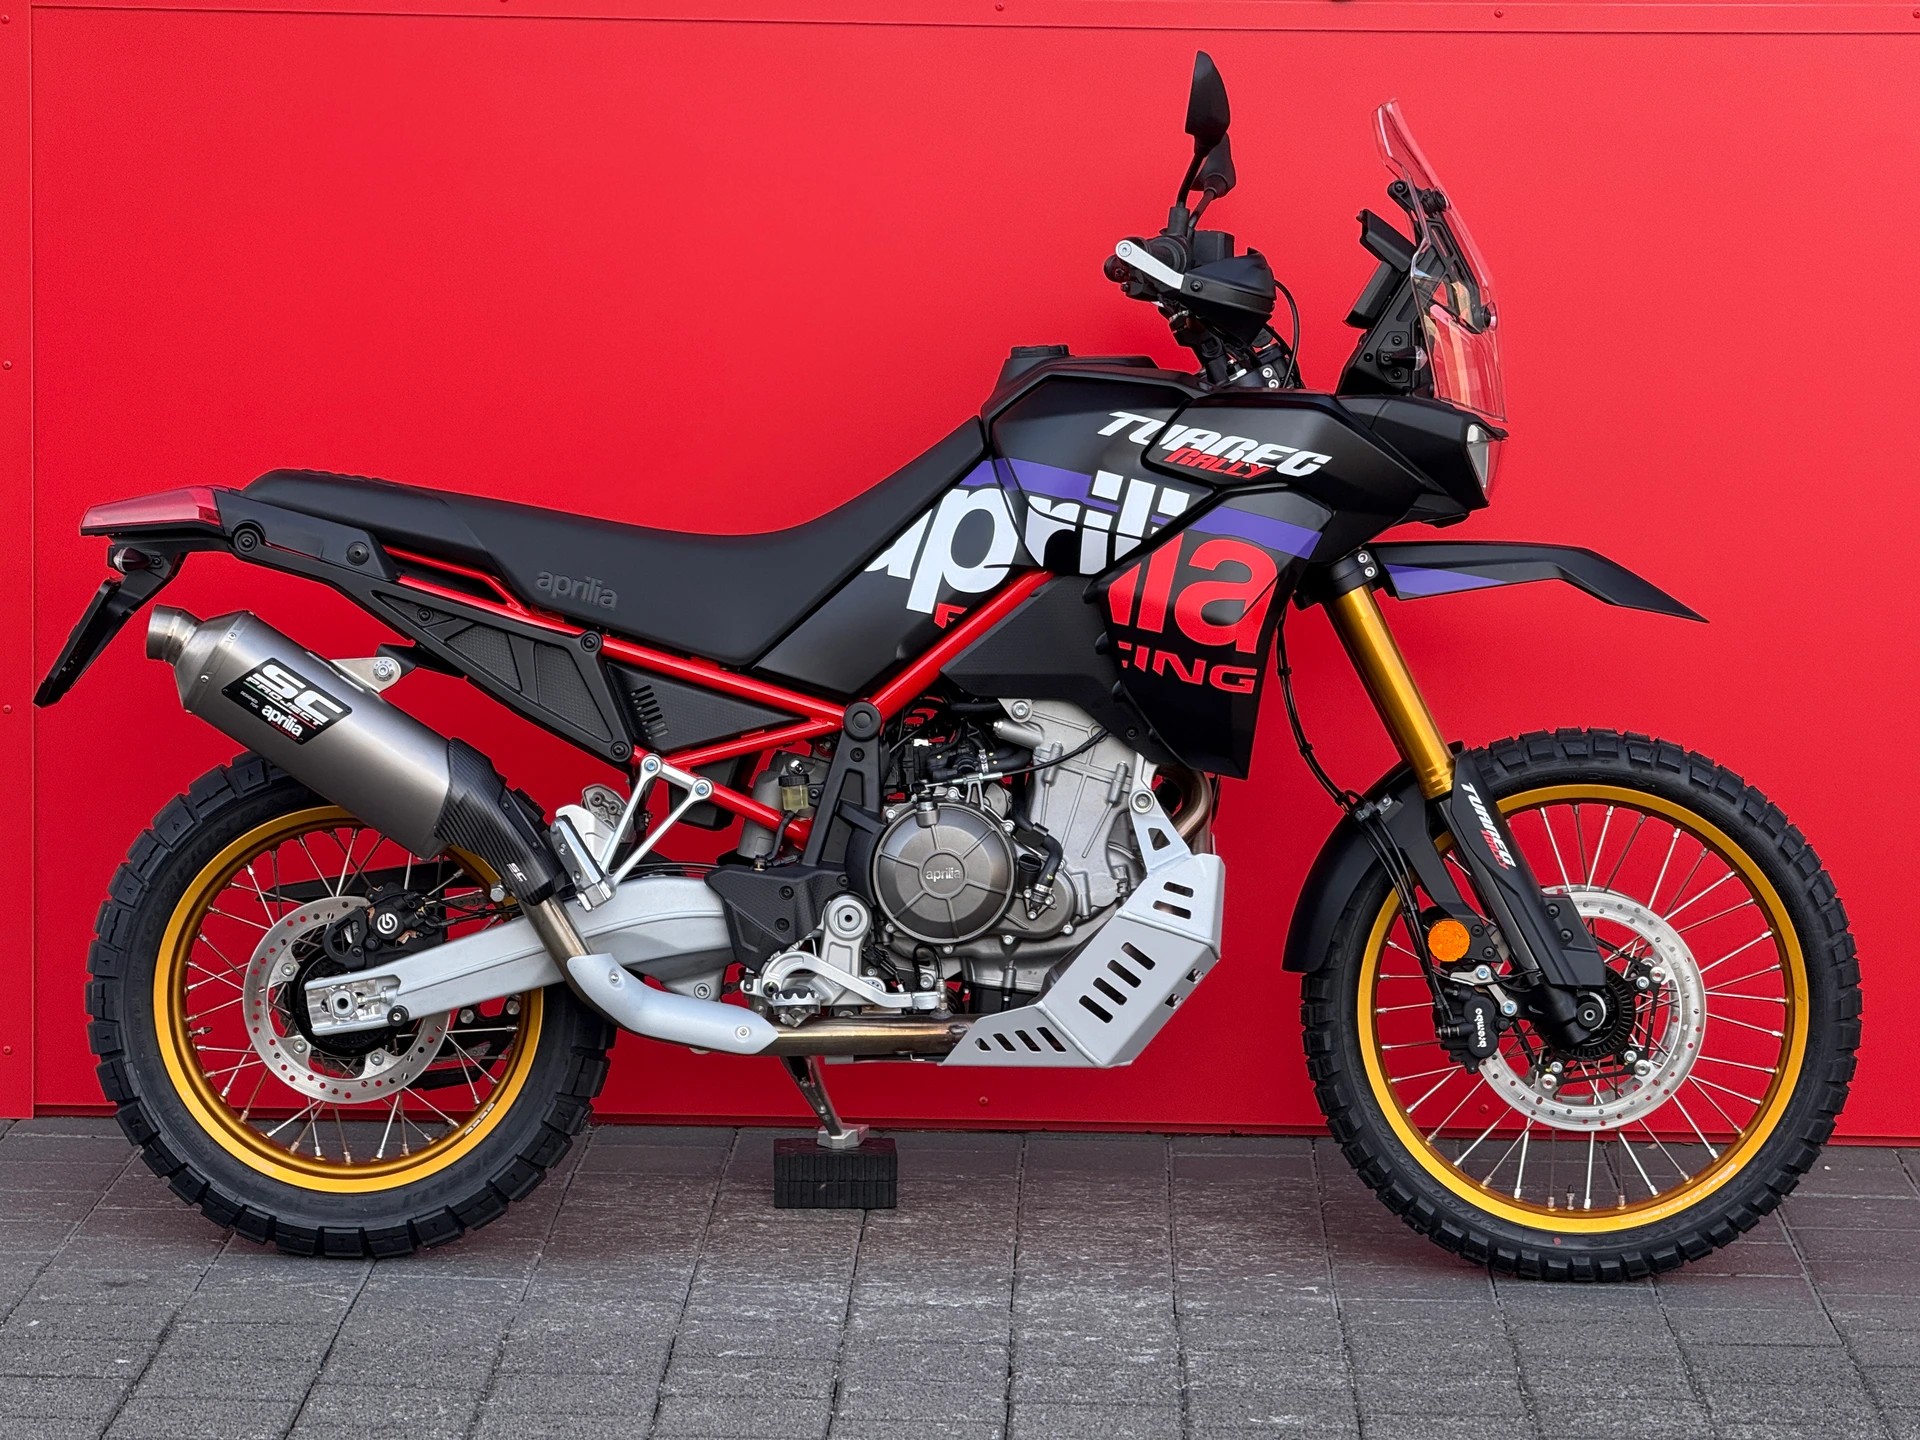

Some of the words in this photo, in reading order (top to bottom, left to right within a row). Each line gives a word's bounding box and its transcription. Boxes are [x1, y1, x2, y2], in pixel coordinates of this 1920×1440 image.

[1097, 411, 1333, 477] TUAREG
[1164, 447, 1271, 479] RALLY
[536, 570, 619, 610] aprilia
[245, 676, 324, 727] PROJECT
[251, 664, 344, 723] SC
[261, 704, 304, 737] aprilia
[1460, 782, 1517, 867] TUAREG
[925, 867, 962, 883] aprilia
[1473, 1007, 1488, 1048] brembo
